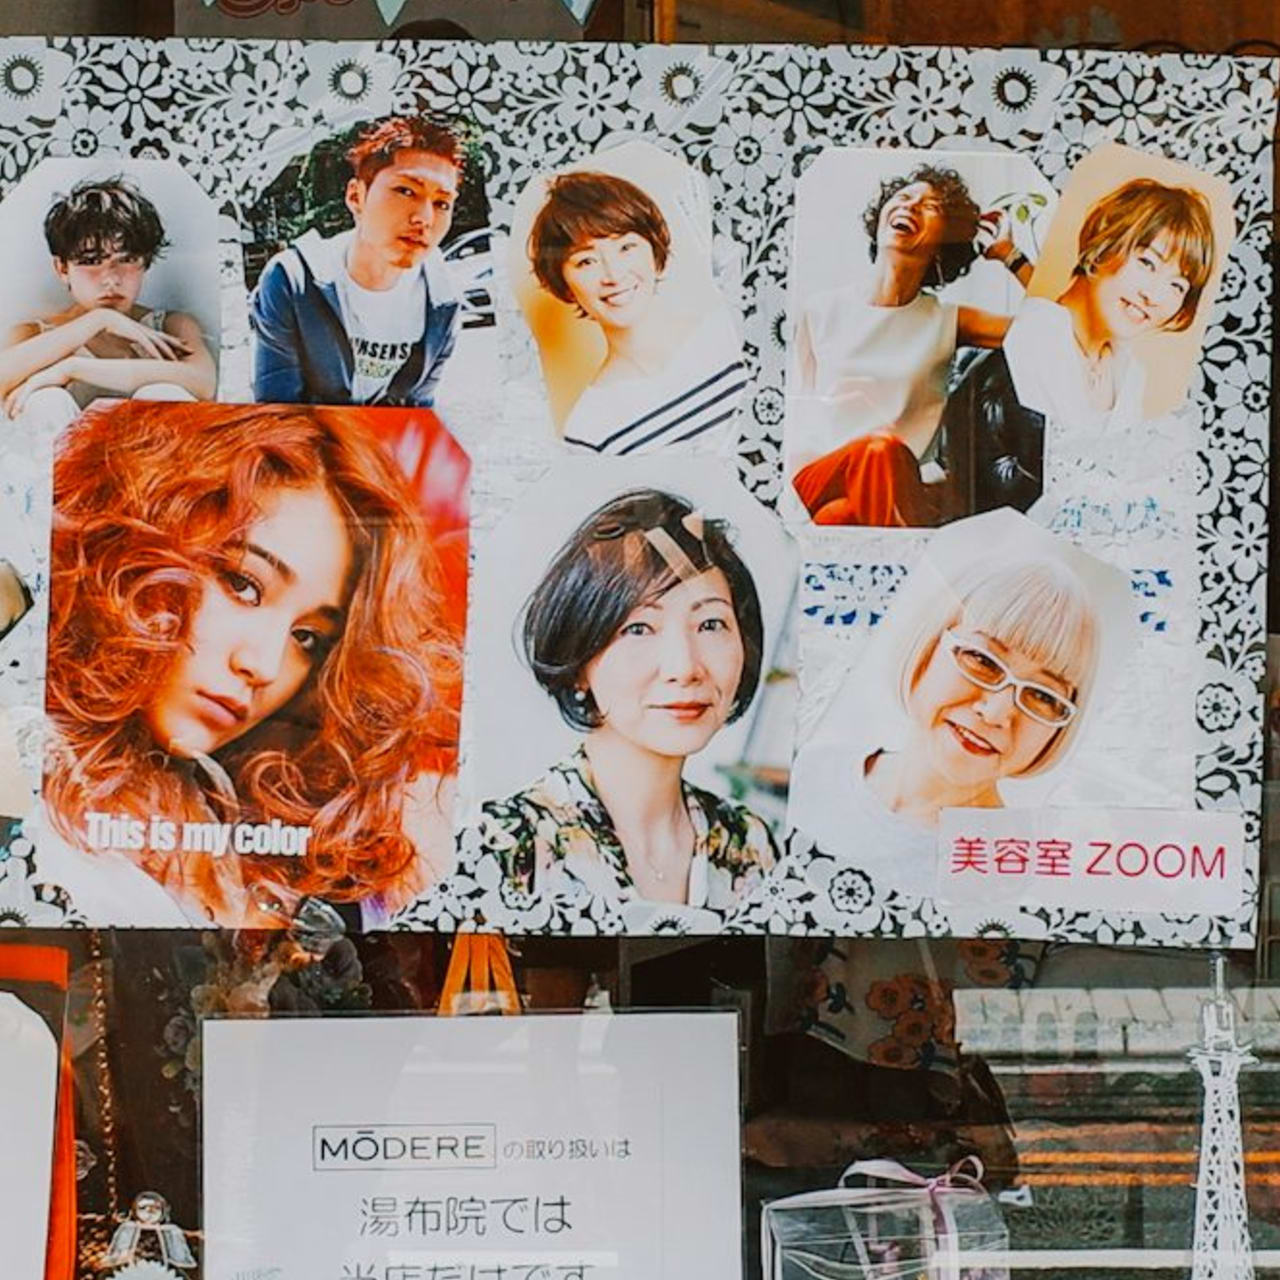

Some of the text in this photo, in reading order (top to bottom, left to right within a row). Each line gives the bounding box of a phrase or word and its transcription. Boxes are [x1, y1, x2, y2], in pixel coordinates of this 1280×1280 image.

[85, 812, 312, 857] This is my color
[950, 837, 1225, 880] 美容室 ZOOM
[503, 1138, 631, 1160] の取り扱いは
[359, 1195, 573, 1237] 湯布院では
